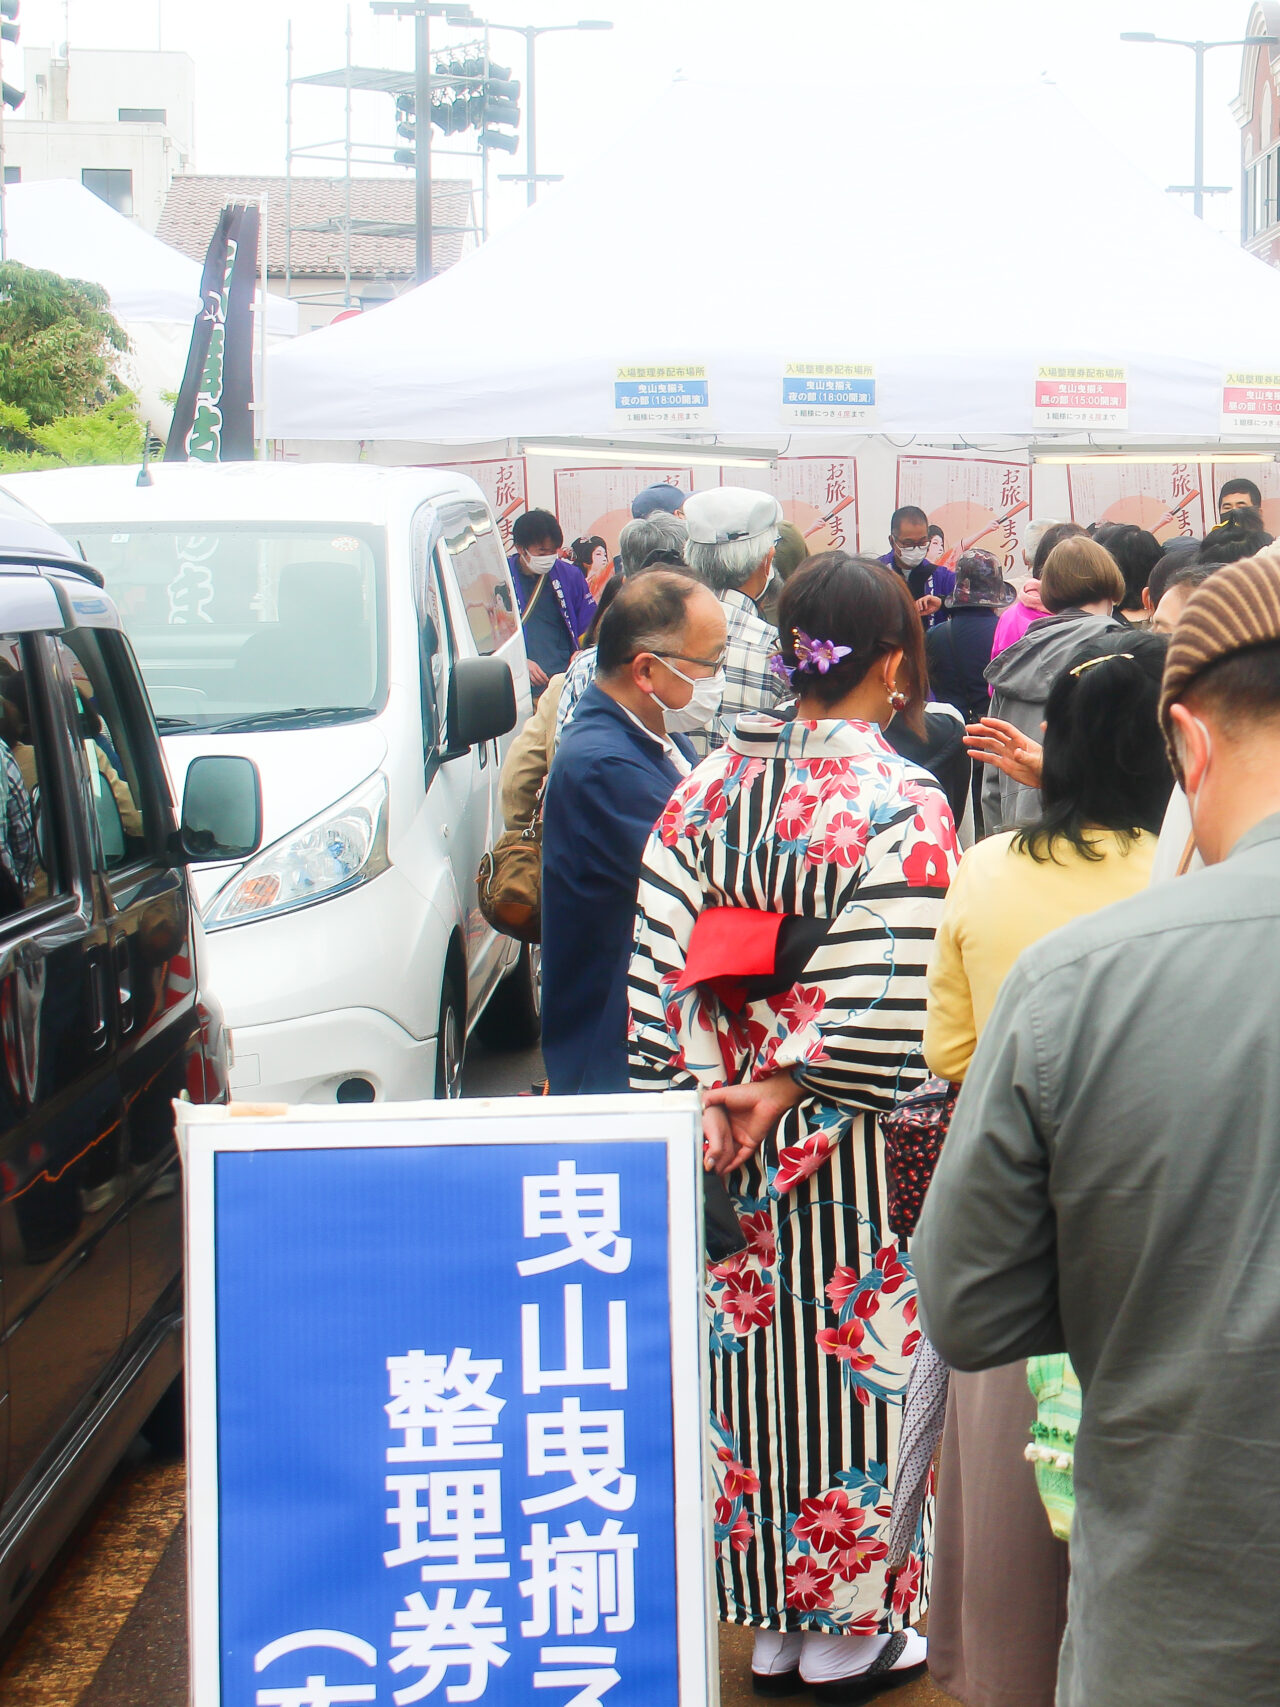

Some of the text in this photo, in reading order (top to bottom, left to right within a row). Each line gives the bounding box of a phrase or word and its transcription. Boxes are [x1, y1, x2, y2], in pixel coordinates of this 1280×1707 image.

[1000, 469, 1021, 573] お旅まつり
[383, 1346, 511, 1707] 整理券
